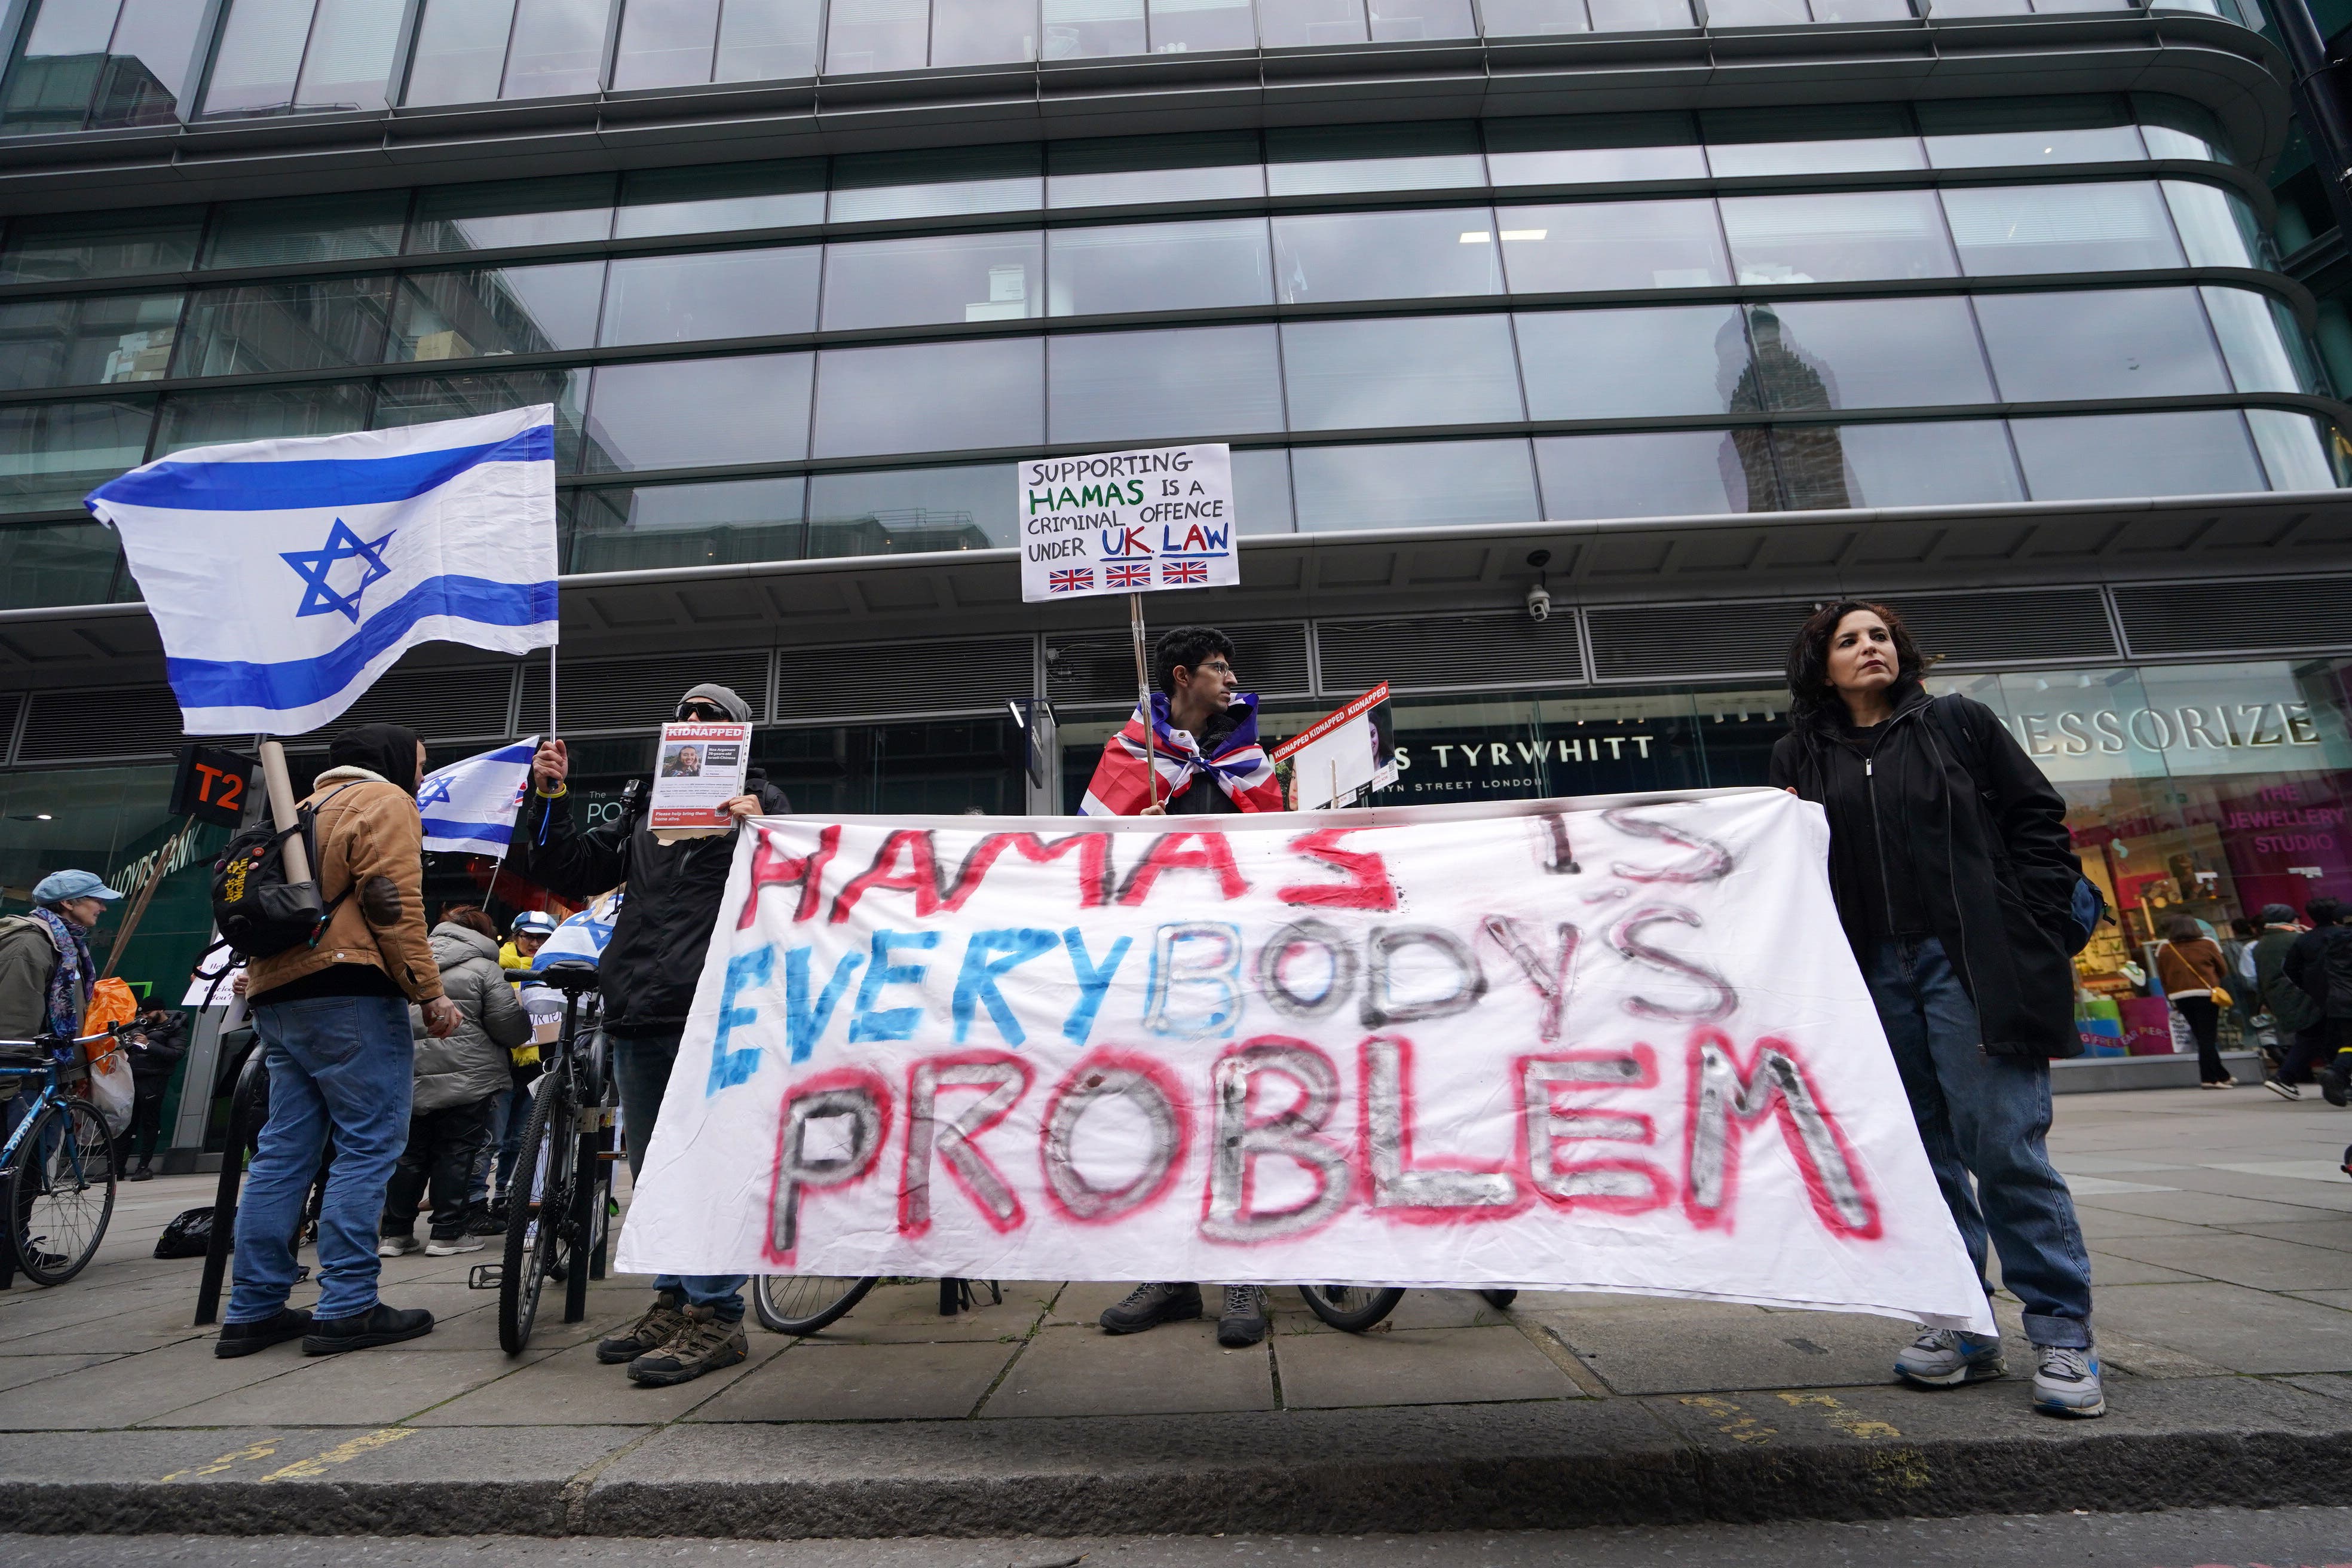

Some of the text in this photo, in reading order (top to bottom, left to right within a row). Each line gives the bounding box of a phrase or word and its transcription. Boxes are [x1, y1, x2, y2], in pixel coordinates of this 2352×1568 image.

[1029, 452, 1193, 486] SUPPORTING
[1030, 479, 1205, 514] HAMAS IS A
[1027, 500, 1223, 534] CRIMINAL OFFENCE
[1028, 538, 1086, 562] UNDER
[1163, 522, 1228, 551] LAW
[669, 728, 742, 737] KIDNAPPED
[1274, 687, 1386, 758] KIDNAPPED KIDNAPPED KIDNAPPED
[1431, 736, 1653, 768] TYRWHITT
[195, 763, 243, 811] T2
[1415, 781, 1472, 791] STREET
[1482, 778, 1542, 788] LONDON
[2259, 785, 2299, 803] THE
[587, 802, 623, 823] PO
[2229, 808, 2344, 829] JEWELLERY
[2255, 832, 2333, 853] STUDIO
[233, 858, 249, 902] Wolfskin
[736, 805, 1736, 930] HAMAS IS
[225, 878, 235, 903] Jack
[2139, 1026, 2170, 1039] PIERC
[761, 1023, 1884, 1266] PROBLEM
